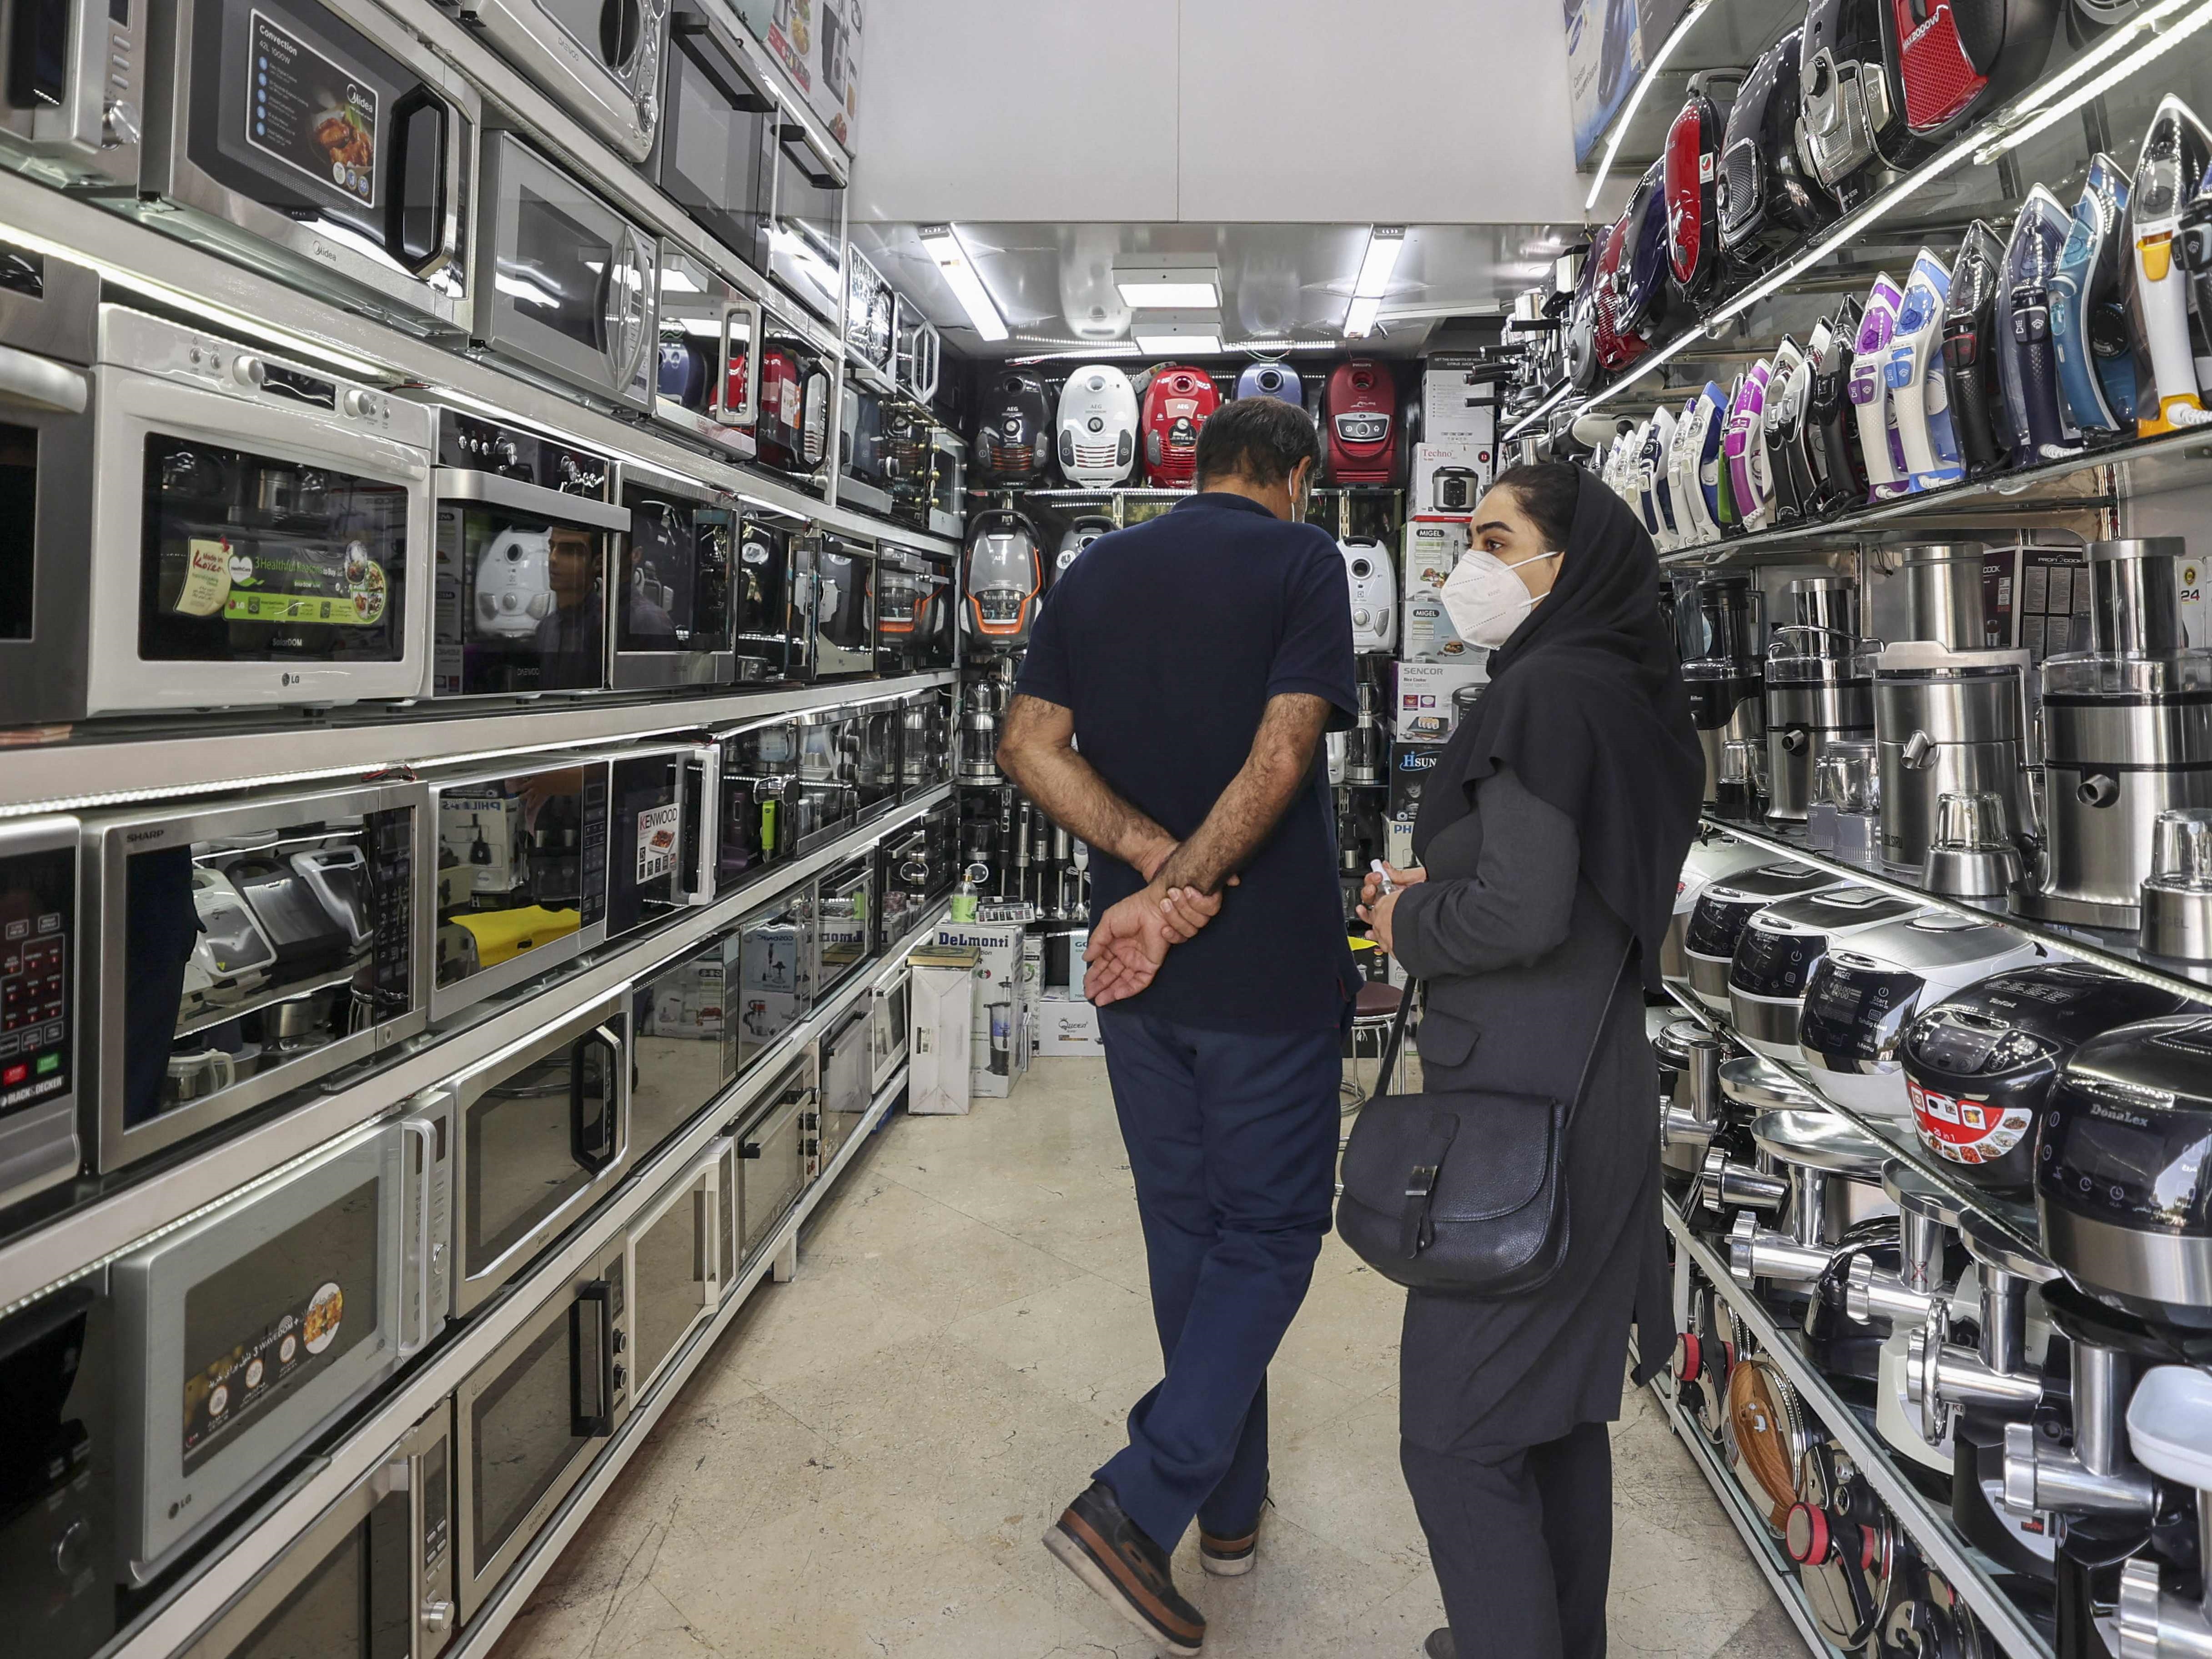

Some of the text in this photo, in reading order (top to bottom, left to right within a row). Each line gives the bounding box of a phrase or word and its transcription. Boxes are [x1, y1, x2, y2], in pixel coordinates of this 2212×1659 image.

[1912, 13, 1940, 41] 2000W
[260, 25, 297, 56] Convection
[558, 36, 578, 61] DAEWOO
[271, 47, 290, 64] 1000W
[347, 84, 373, 113] Midea
[313, 240, 336, 261] Midea
[1423, 449, 1452, 457] Techno
[261, 559, 296, 572] Healthful
[1983, 565, 2000, 573] COOK
[2181, 589, 2200, 601] 24
[1403, 667, 1443, 676] SENCOR
[291, 675, 300, 684] LG
[639, 808, 677, 830] KENWOOD
[1394, 824, 1412, 834] PH
[126, 830, 164, 842] SHARP
[1873, 995, 1888, 1005] Start
[1989, 997, 2017, 1009] Tefal
[1857, 1041, 1874, 1053] Menu
[2091, 1104, 2148, 1127] DonaLex
[259, 1321, 293, 1351] WAVEDOM
[181, 1494, 192, 1508] LG
